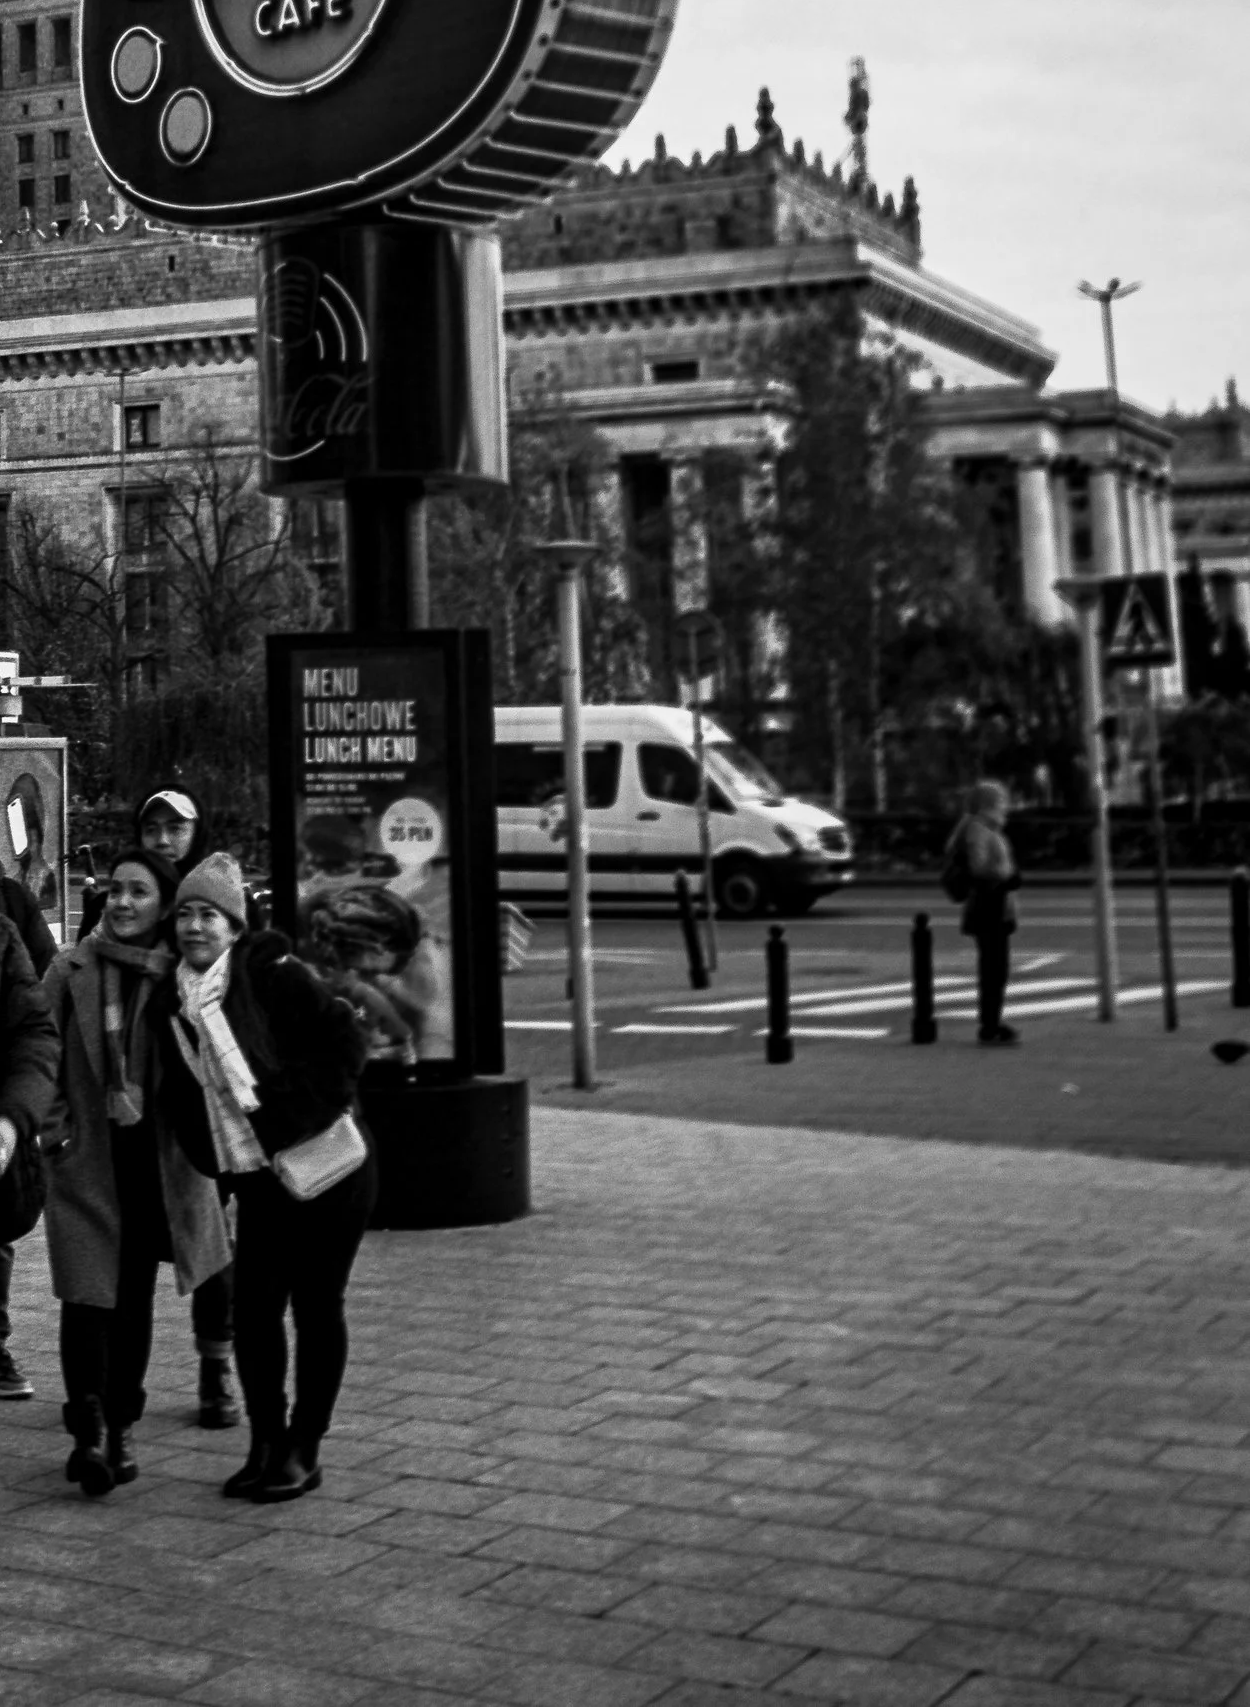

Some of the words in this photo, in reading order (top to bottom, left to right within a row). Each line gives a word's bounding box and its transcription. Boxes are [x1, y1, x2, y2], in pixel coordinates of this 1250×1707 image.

[303, 667, 359, 698] MENU
[303, 700, 417, 731] LUNCHOWE
[304, 736, 362, 763] LUNCH
[366, 736, 417, 763] MENU
